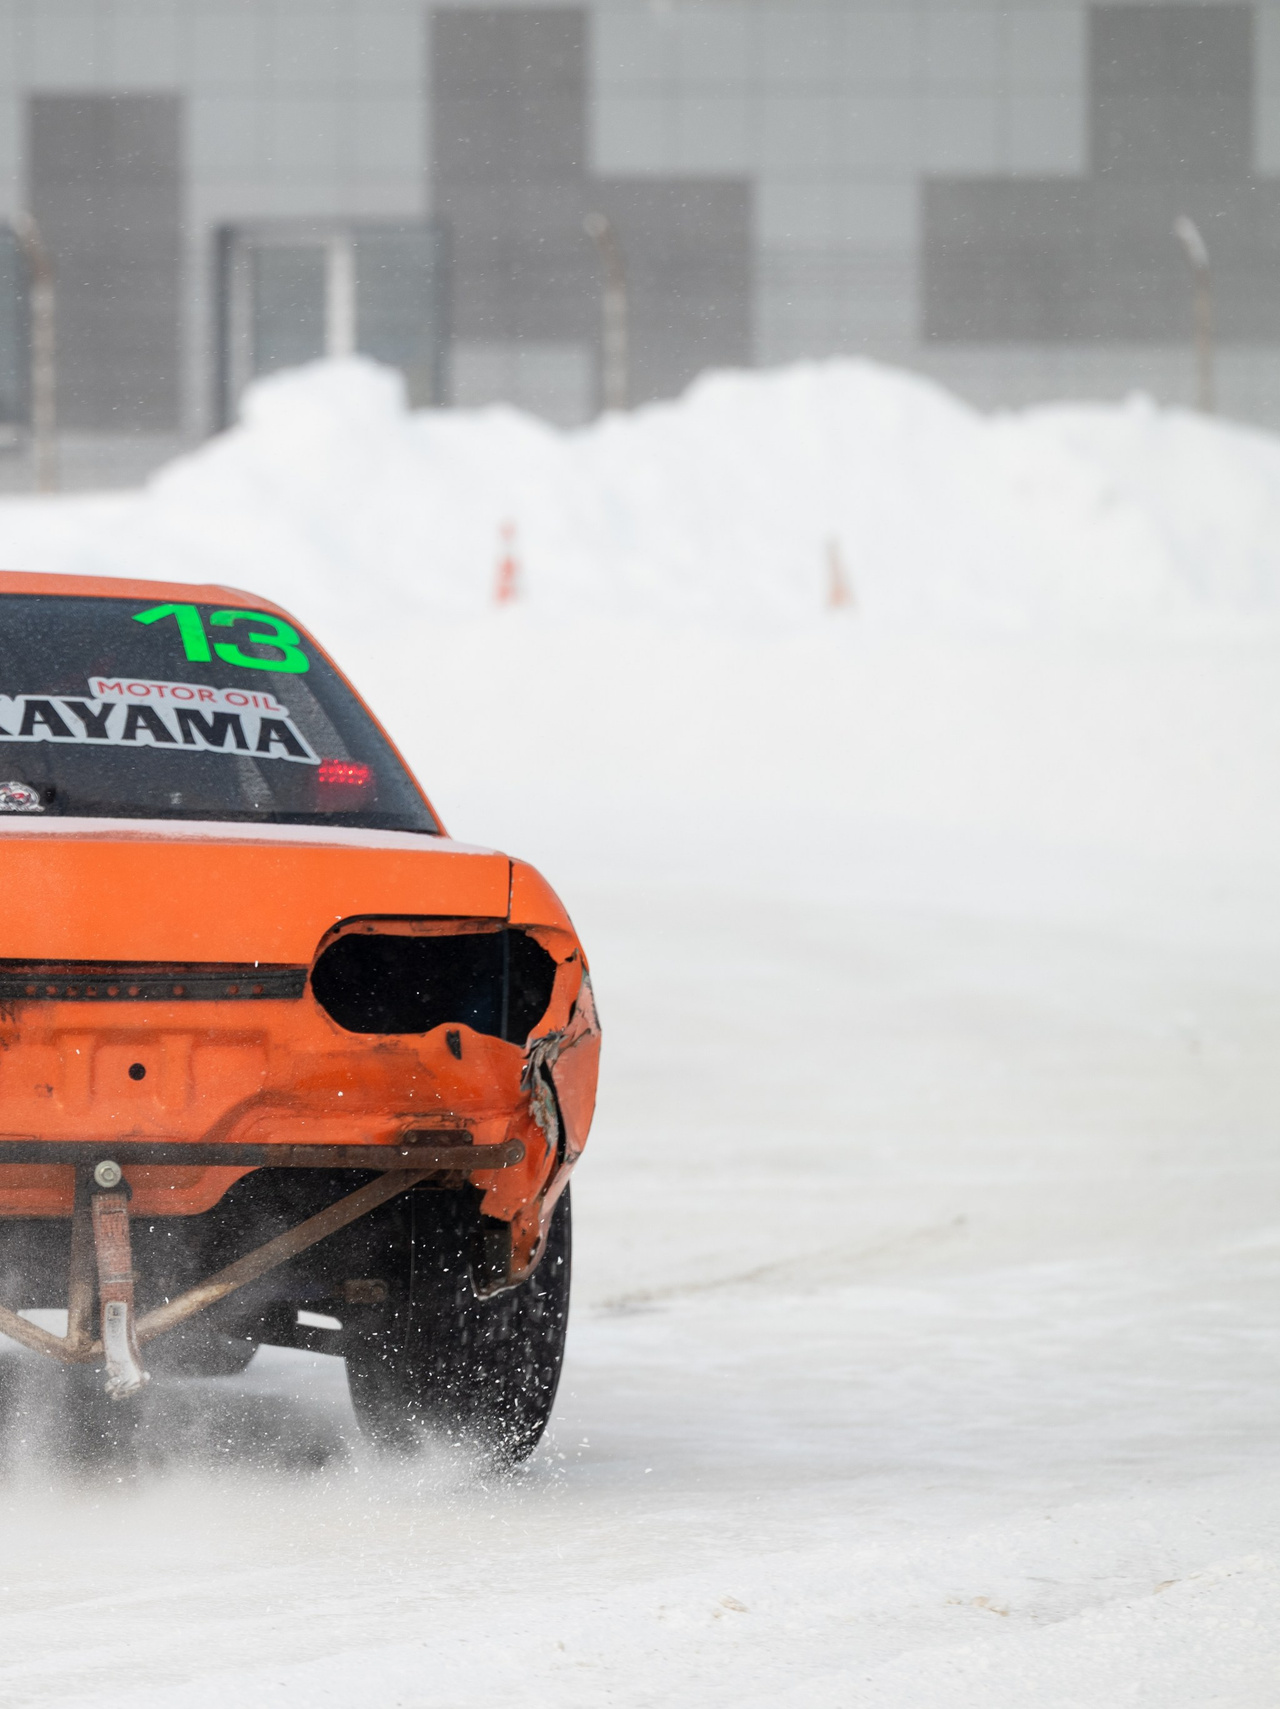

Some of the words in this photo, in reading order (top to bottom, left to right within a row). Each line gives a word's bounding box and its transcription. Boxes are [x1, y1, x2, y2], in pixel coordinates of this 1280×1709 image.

[131, 604, 310, 674] 13
[97, 681, 217, 703] MOTOR
[225, 692, 281, 712] OIL
